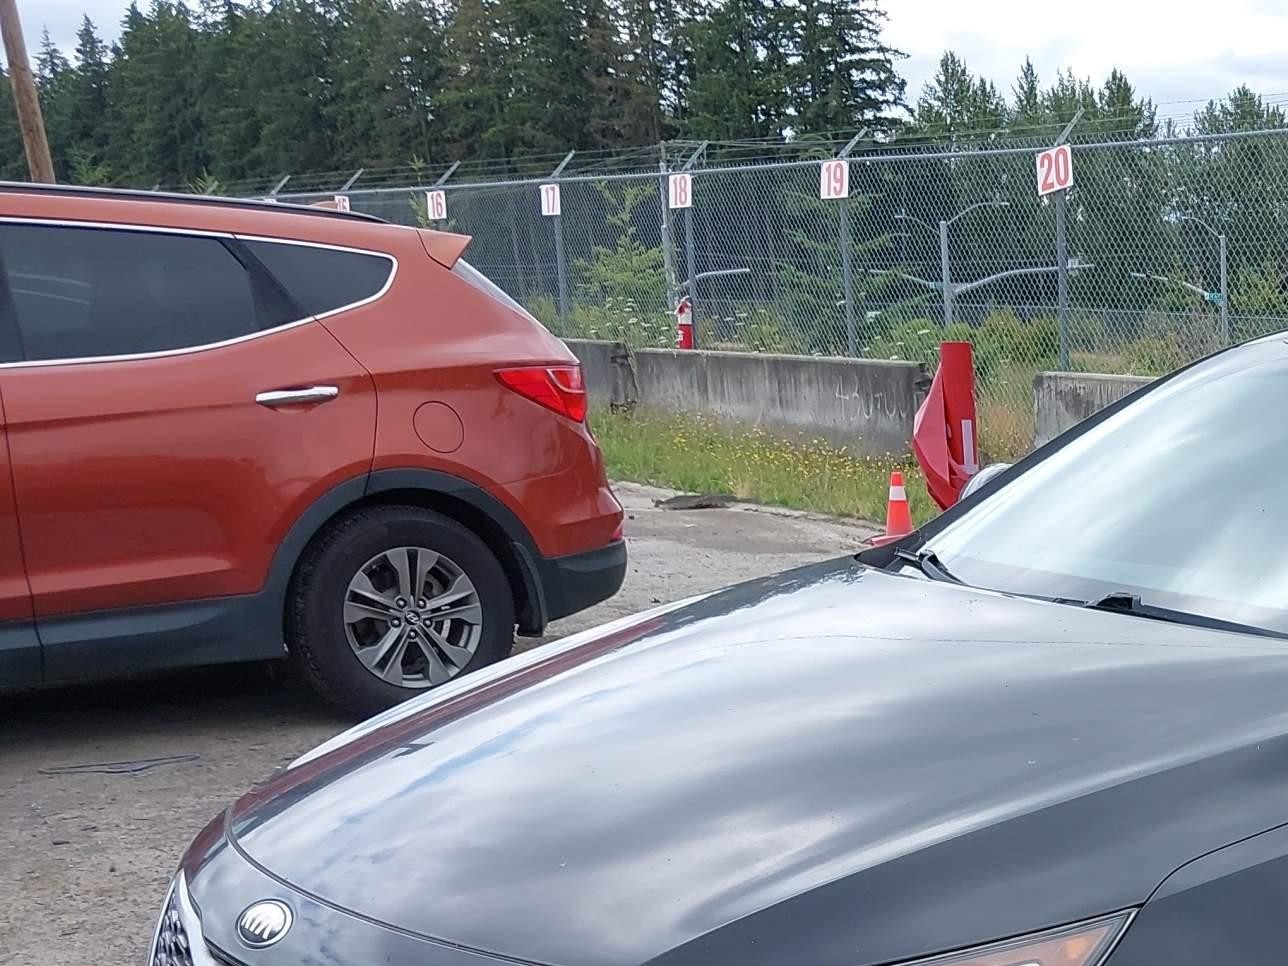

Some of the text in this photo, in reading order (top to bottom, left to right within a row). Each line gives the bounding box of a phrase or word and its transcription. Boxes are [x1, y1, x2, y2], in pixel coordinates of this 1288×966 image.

[825, 164, 845, 195] 19
[1039, 147, 1071, 193] 20
[431, 194, 444, 218] 16
[544, 186, 556, 213] 17
[672, 175, 689, 206] 18
